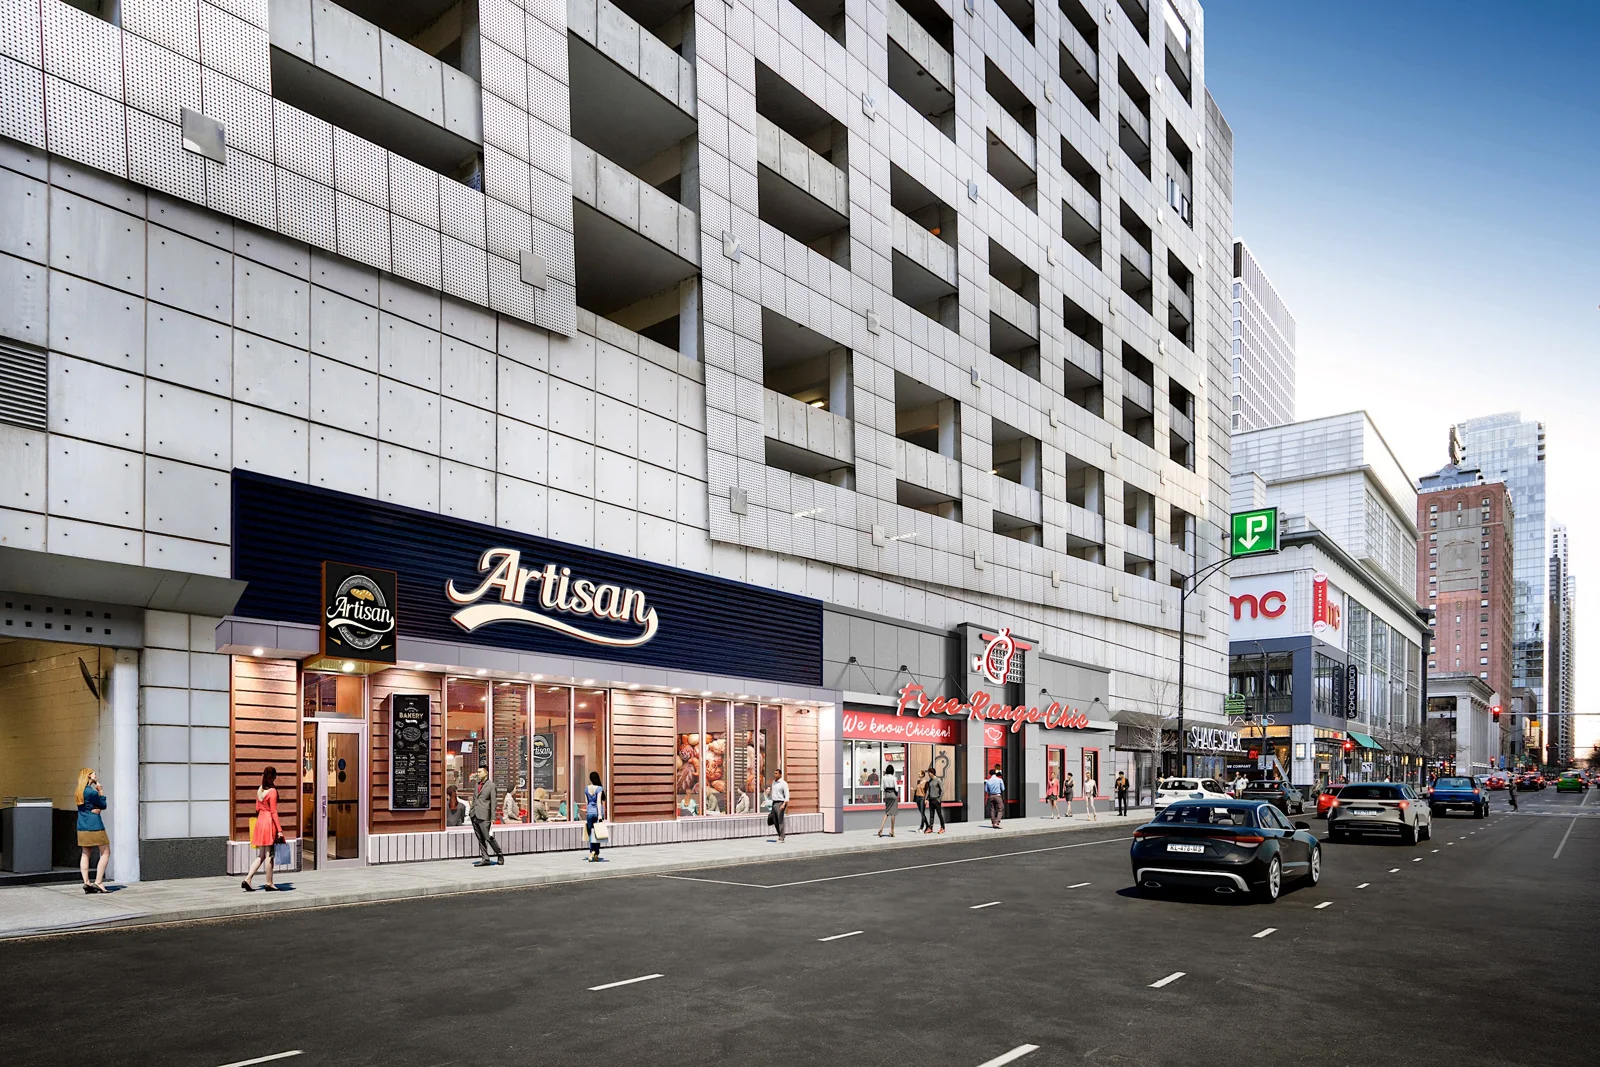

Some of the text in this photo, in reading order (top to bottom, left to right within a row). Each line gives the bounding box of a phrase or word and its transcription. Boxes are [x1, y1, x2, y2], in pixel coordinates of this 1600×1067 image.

[326, 596, 394, 633] Artisan
[445, 547, 660, 646] Artisan
[843, 714, 951, 738] We know Chicken!
